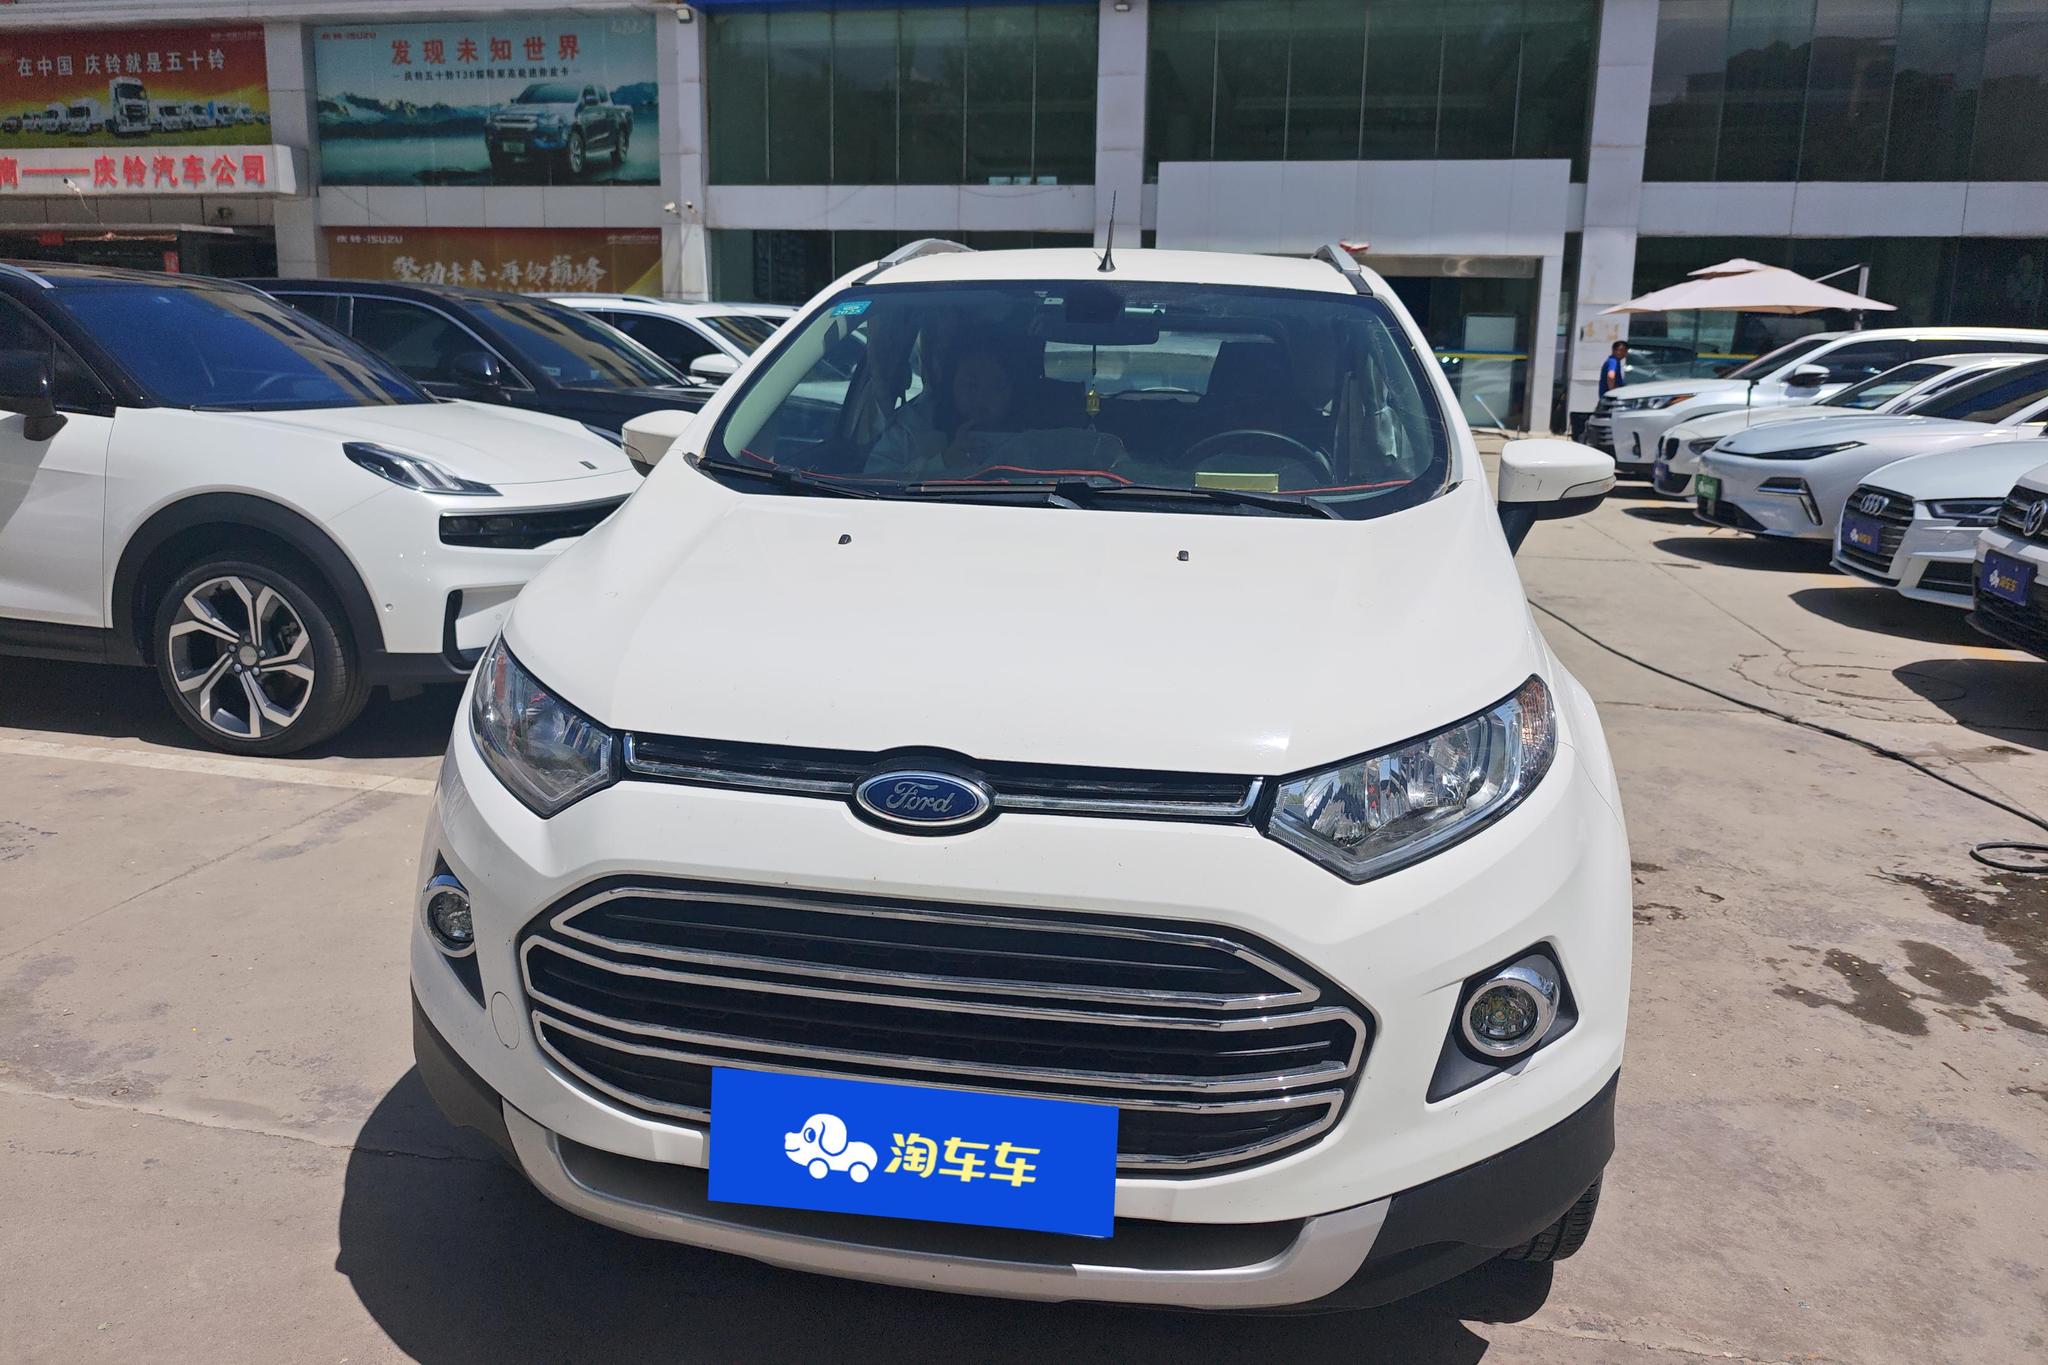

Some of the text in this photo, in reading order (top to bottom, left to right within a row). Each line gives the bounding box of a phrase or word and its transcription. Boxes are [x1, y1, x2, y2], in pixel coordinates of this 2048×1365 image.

[17, 48, 225, 77] 在中国 庆铃就是五十铃
[391, 34, 581, 65] 发现未知世界
[885, 781, 956, 813] Ford
